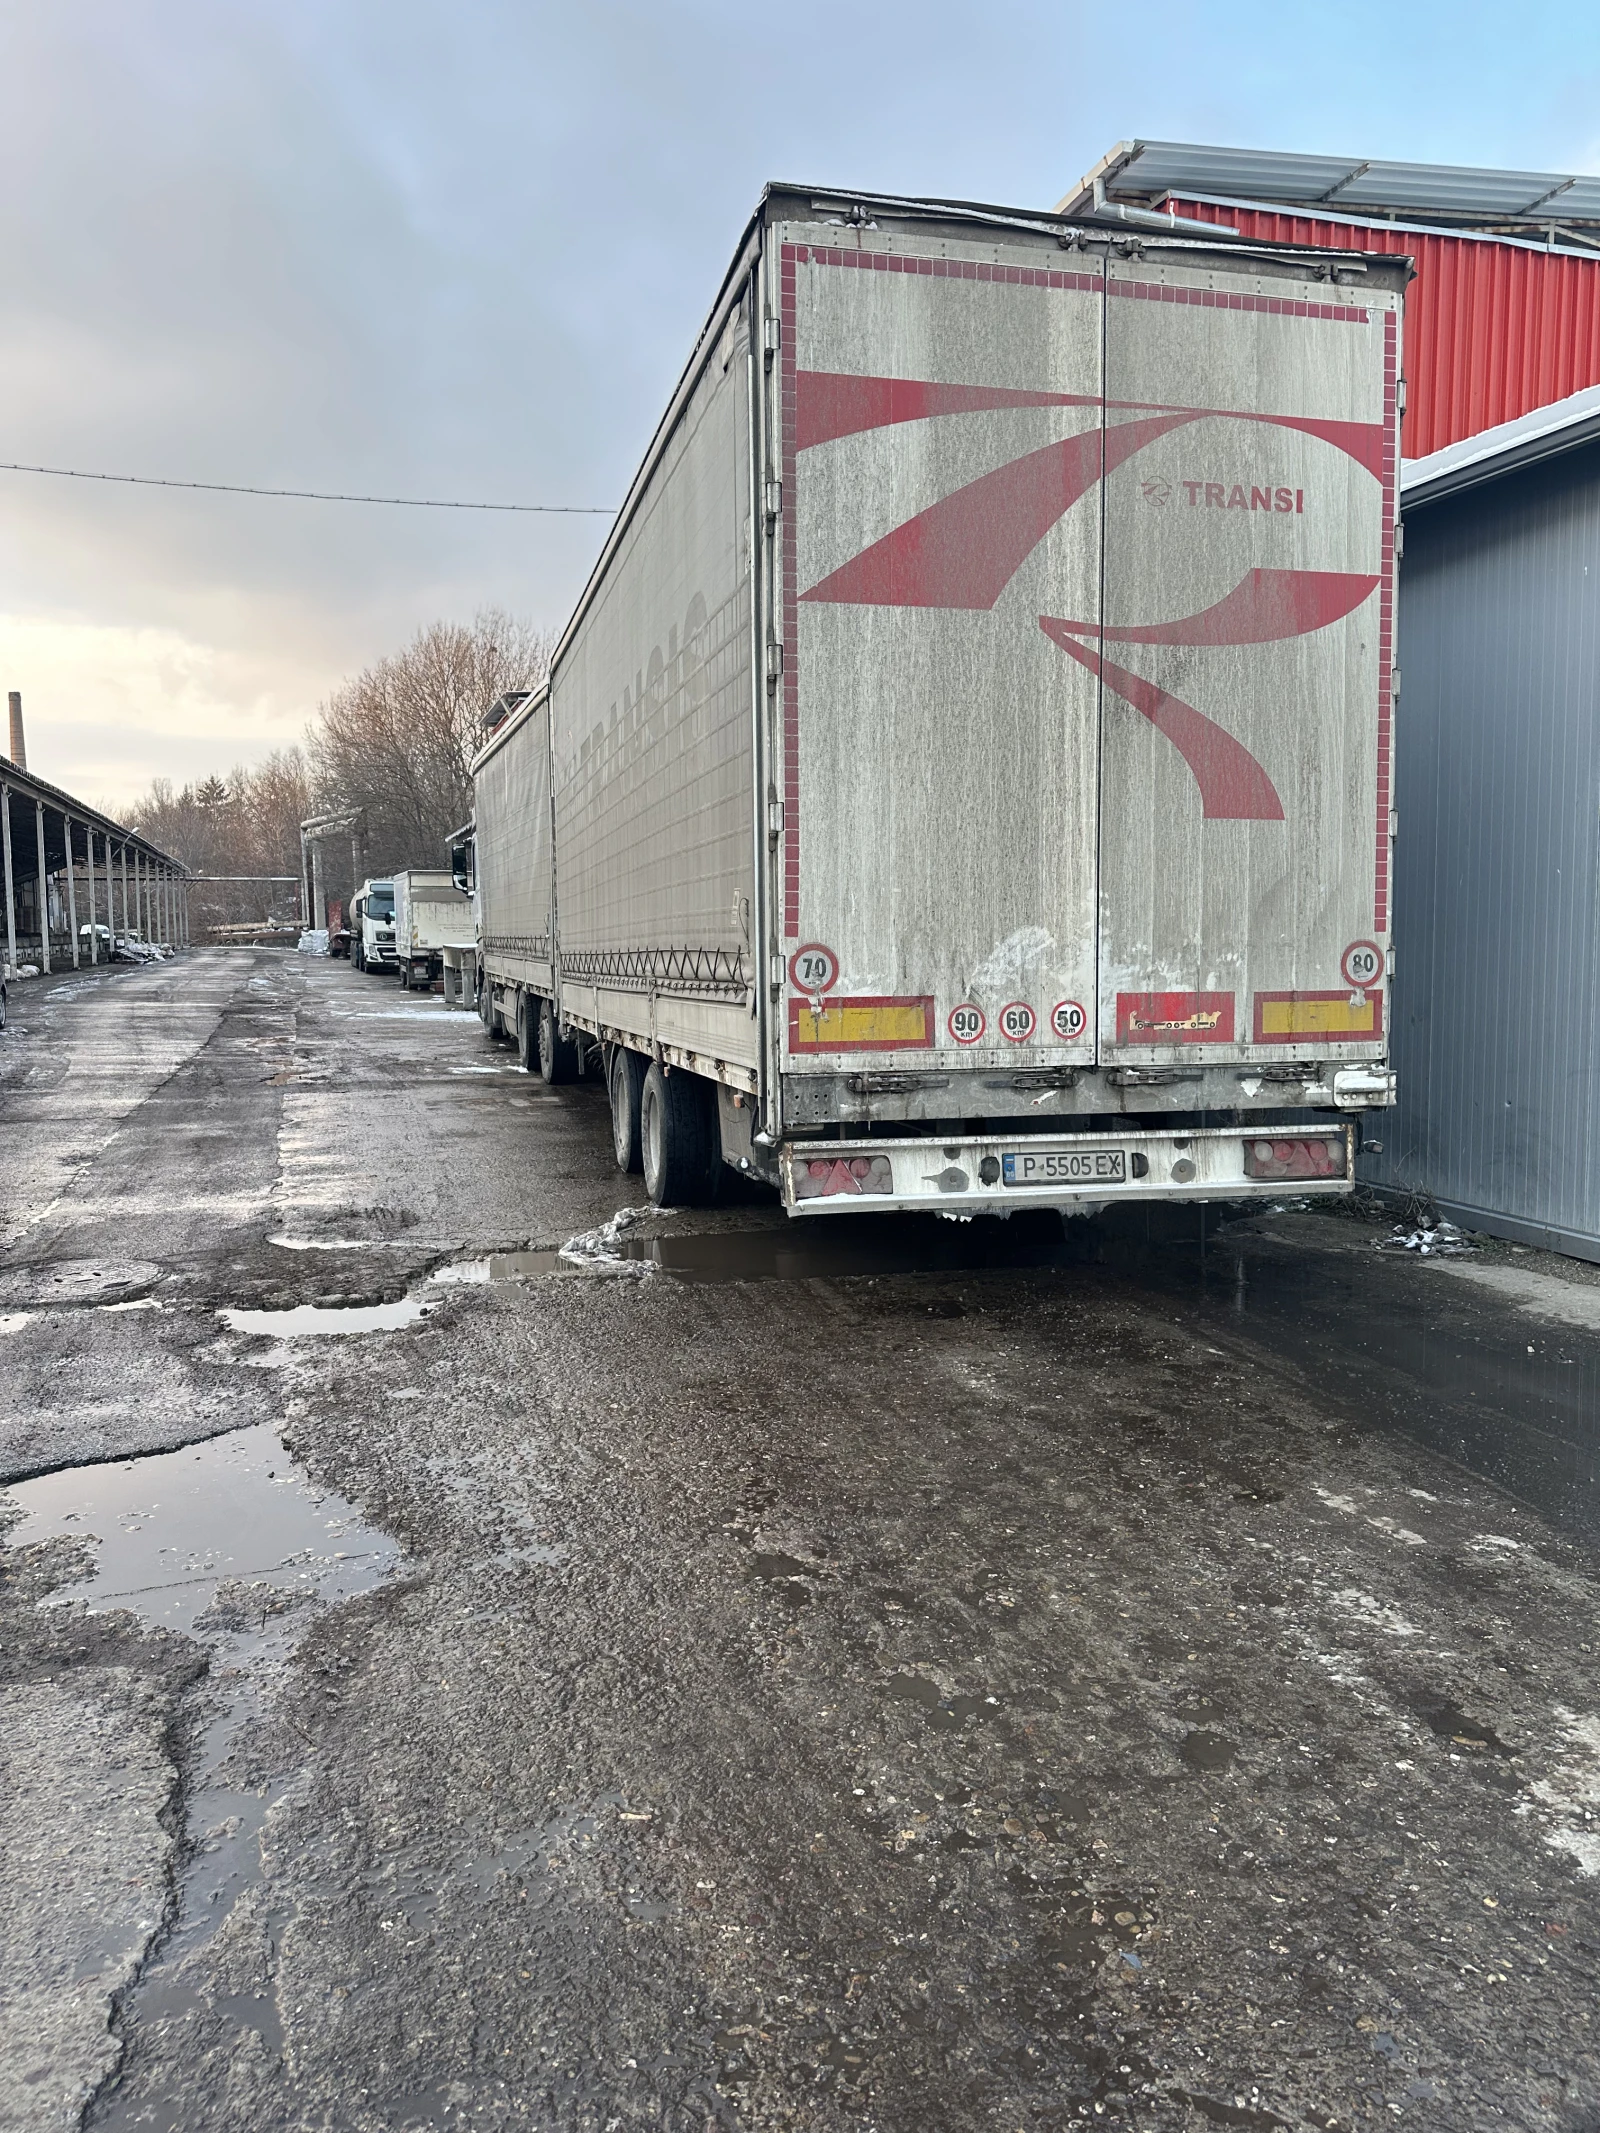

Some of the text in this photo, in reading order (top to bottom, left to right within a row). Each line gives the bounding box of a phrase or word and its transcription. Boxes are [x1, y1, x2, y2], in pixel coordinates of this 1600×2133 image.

[802, 956, 827, 979] 70
[1353, 953, 1374, 974] 80
[954, 1012, 979, 1031] 90
[1006, 1010, 1030, 1029] 60
[1057, 1009, 1081, 1027] 50
[1046, 1156, 1092, 1177] 5505
[1096, 1155, 1120, 1176] EX
